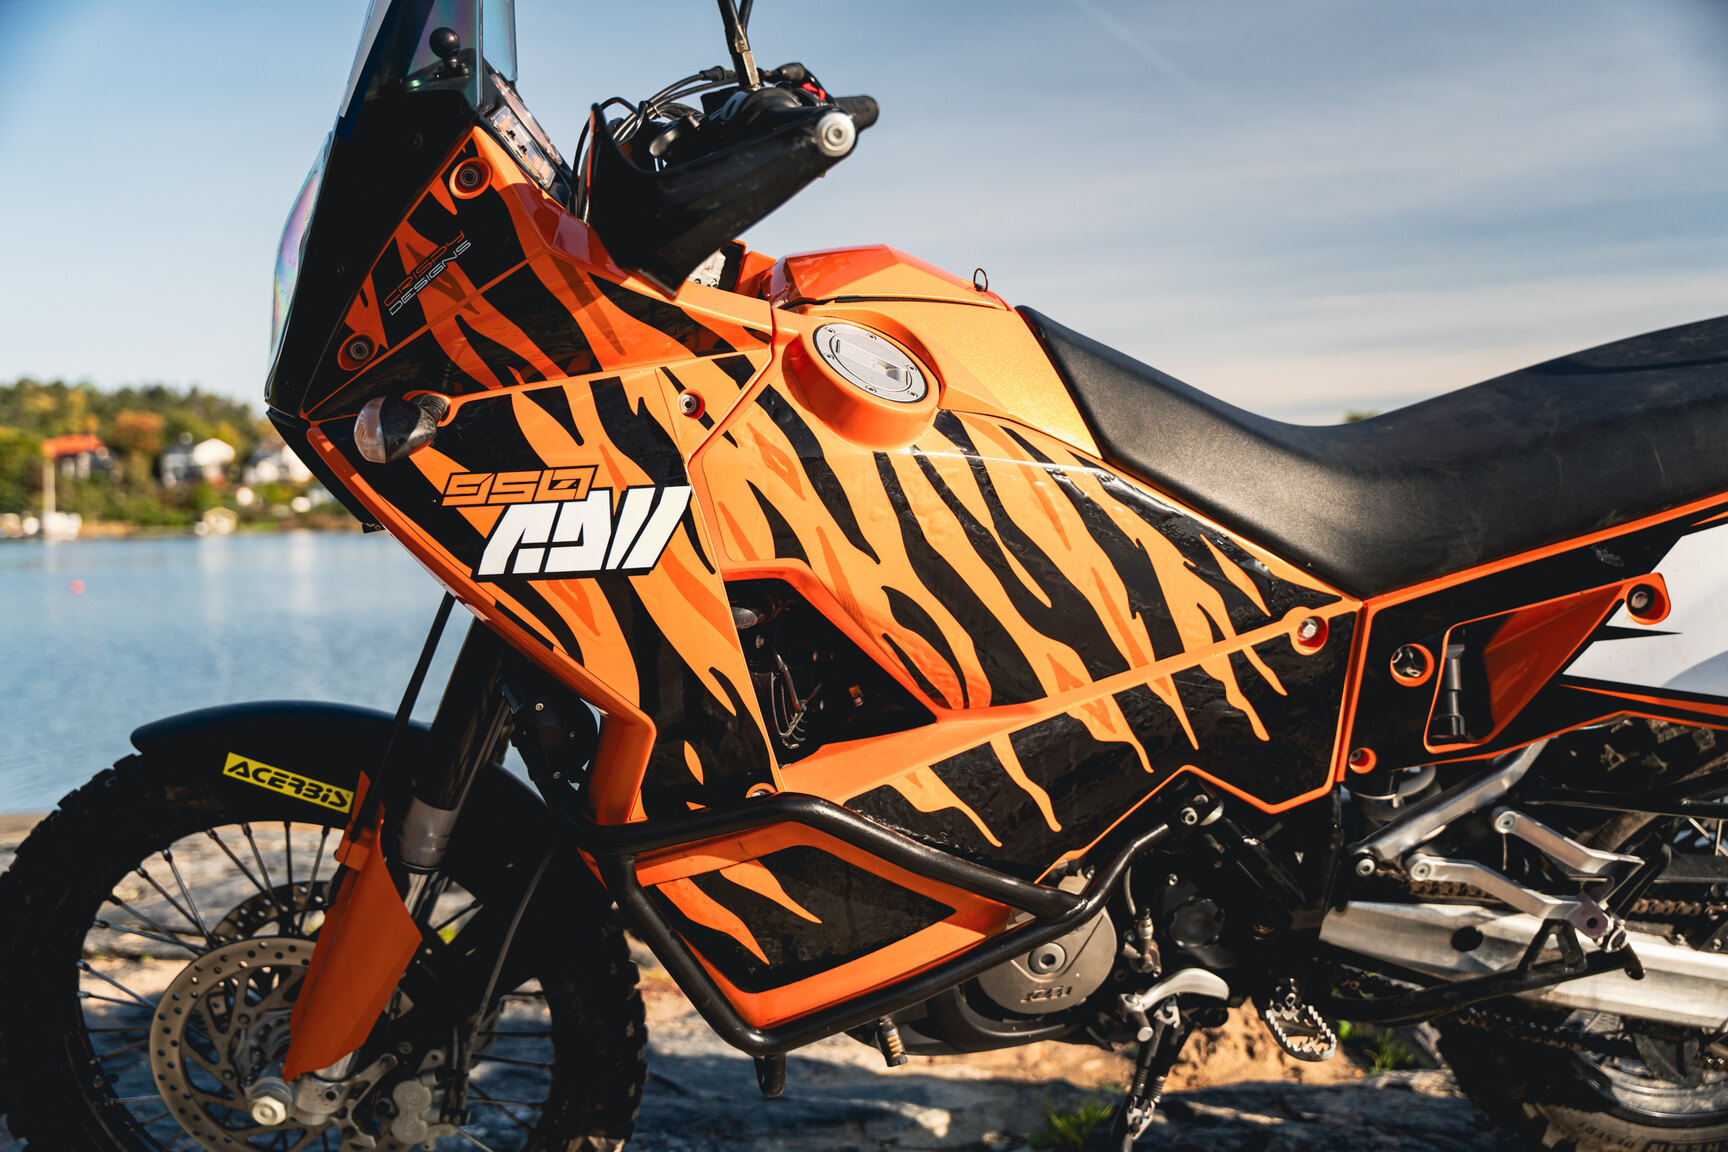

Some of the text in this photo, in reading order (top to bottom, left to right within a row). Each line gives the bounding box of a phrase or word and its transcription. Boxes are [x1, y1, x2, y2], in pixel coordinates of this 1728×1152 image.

[384, 230, 465, 307] CRISPY
[389, 240, 471, 315] DESIGNS
[441, 466, 598, 507] 950
[477, 486, 692, 576] ADV
